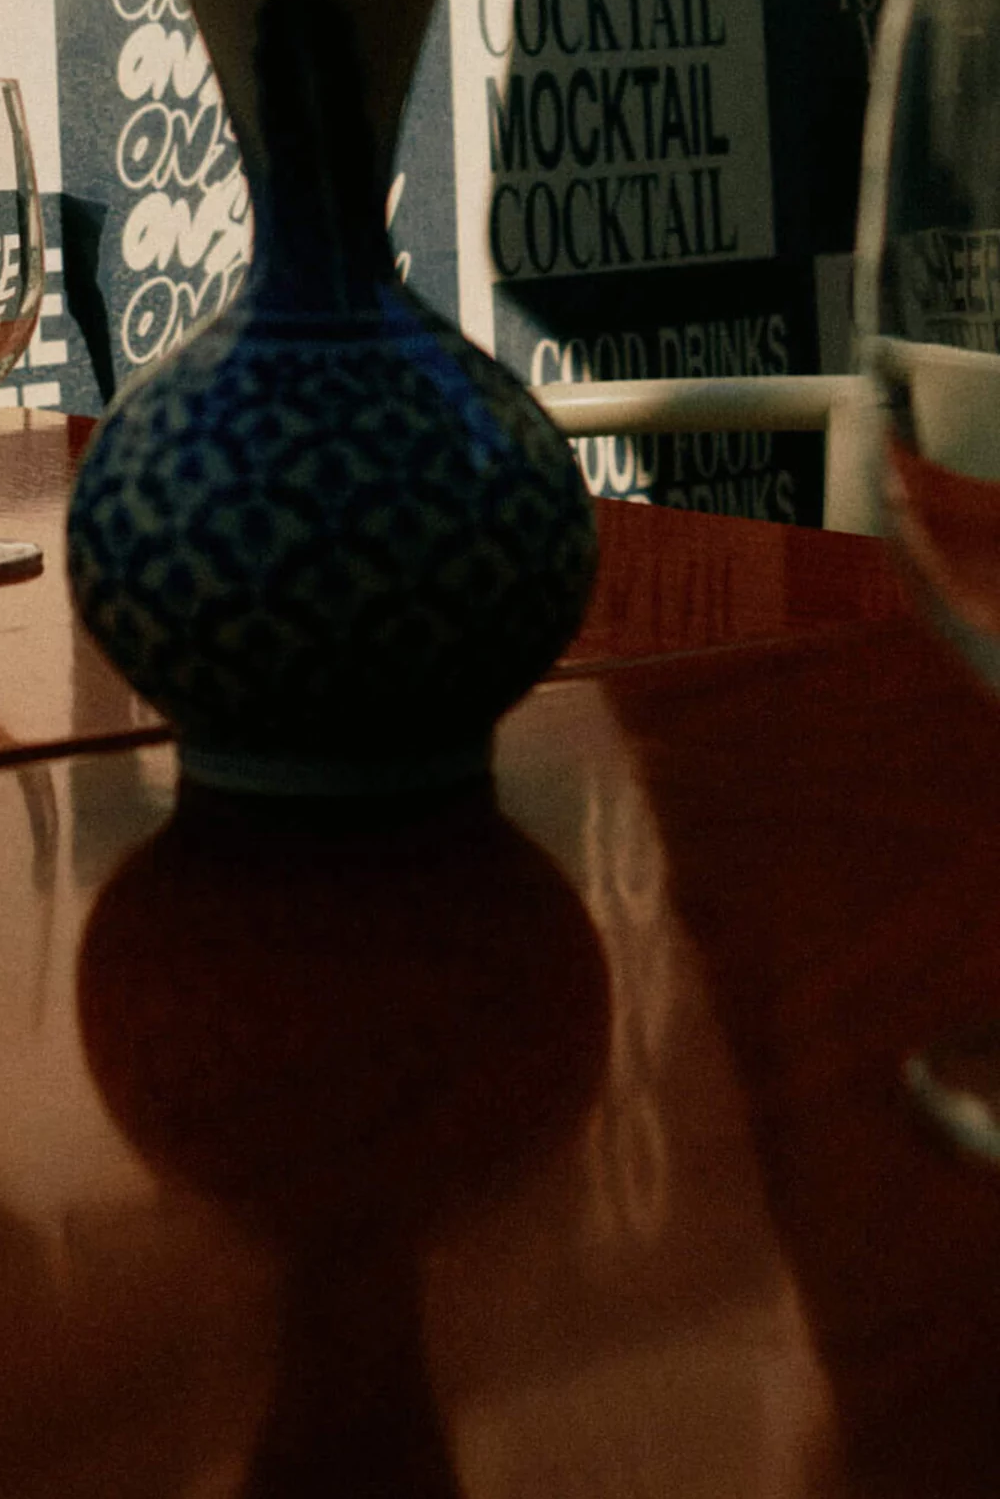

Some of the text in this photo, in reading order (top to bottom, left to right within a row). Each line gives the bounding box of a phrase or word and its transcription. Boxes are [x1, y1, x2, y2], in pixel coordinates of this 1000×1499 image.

[486, 62, 729, 173] MOCKTAIL
[490, 168, 738, 278] COCKTAIL
[656, 312, 790, 378] DRINKS
[566, 433, 661, 497] OOD
